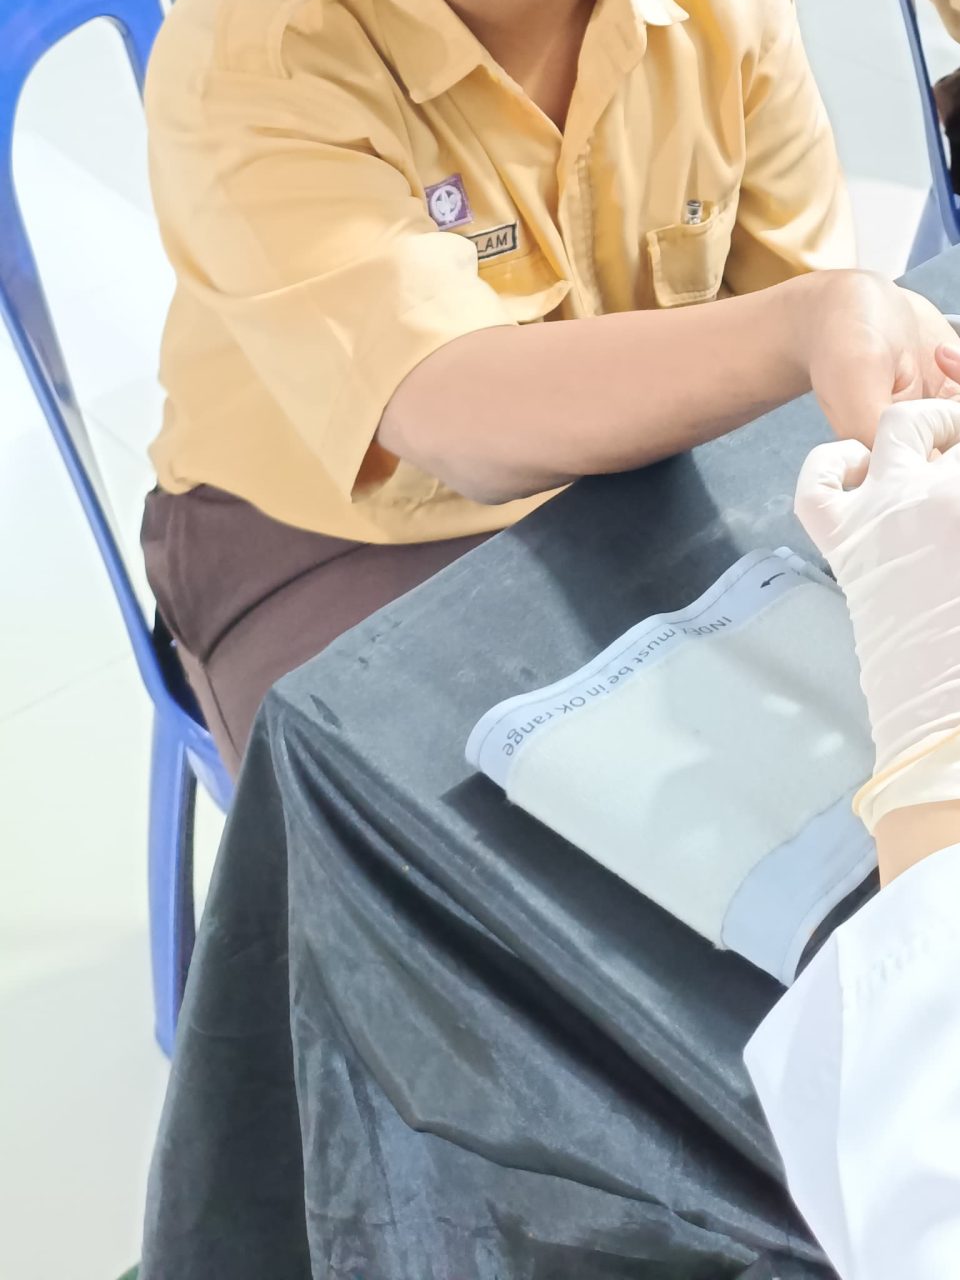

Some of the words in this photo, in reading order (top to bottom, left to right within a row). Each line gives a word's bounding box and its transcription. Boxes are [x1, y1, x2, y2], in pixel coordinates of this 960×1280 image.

[634, 628, 676, 664] must
[608, 666, 635, 685] be
[586, 683, 610, 697] in
[555, 696, 586, 714] OK
[502, 711, 554, 757] range
